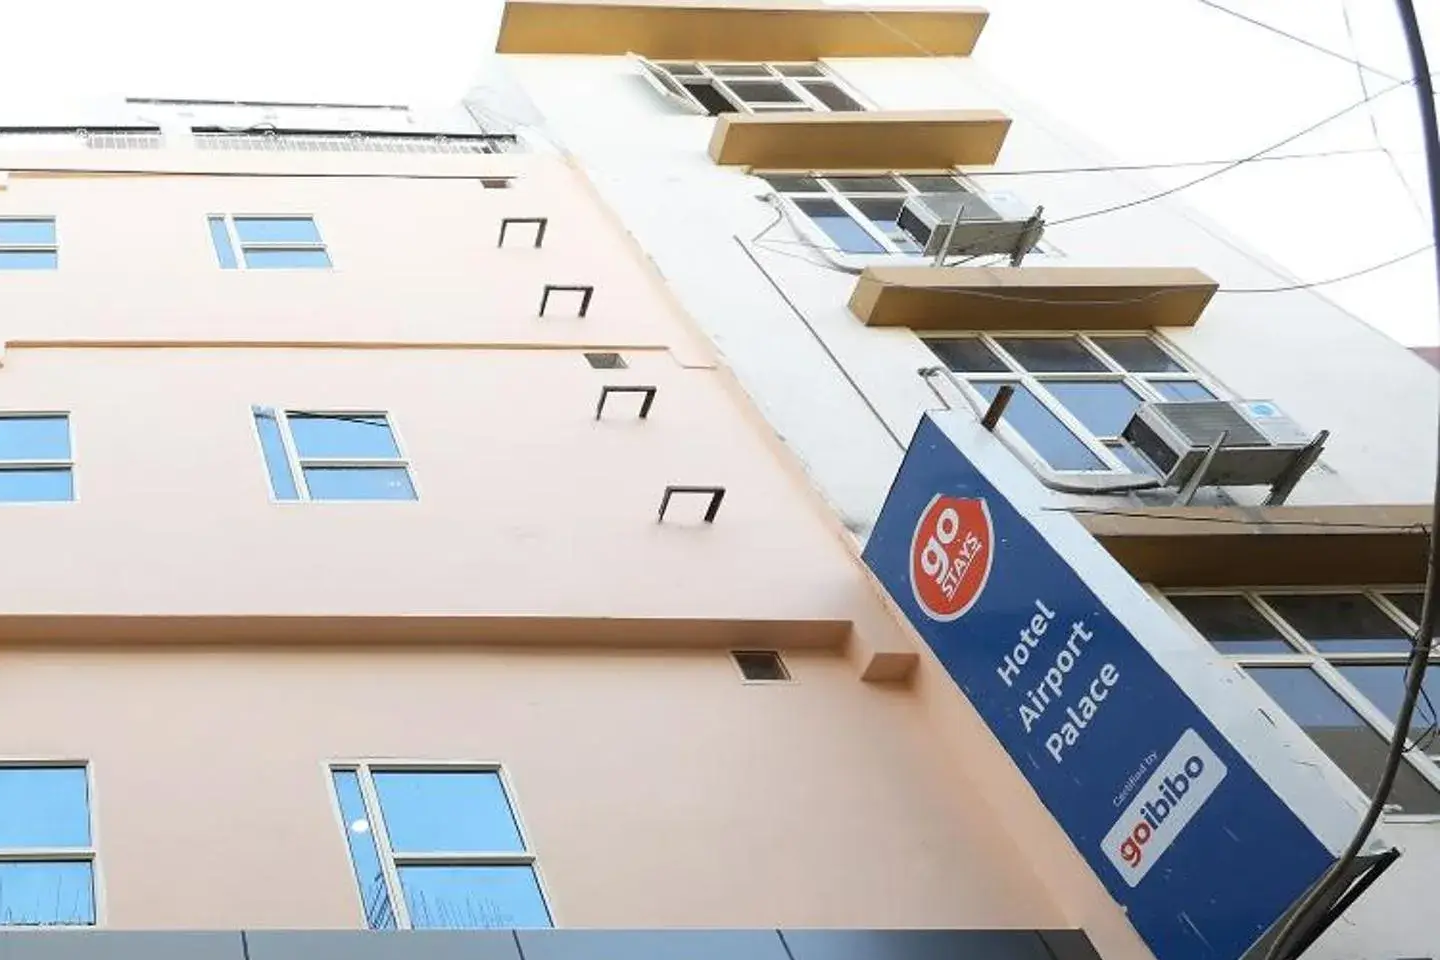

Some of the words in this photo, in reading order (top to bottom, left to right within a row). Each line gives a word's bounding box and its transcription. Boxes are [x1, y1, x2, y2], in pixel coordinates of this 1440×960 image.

[921, 508, 959, 585] go
[941, 531, 982, 602] STAYS
[996, 598, 1056, 688] Hotel
[1018, 620, 1094, 734] Airport
[1045, 663, 1120, 764] Palace
[1120, 755, 1204, 868] goibibo
